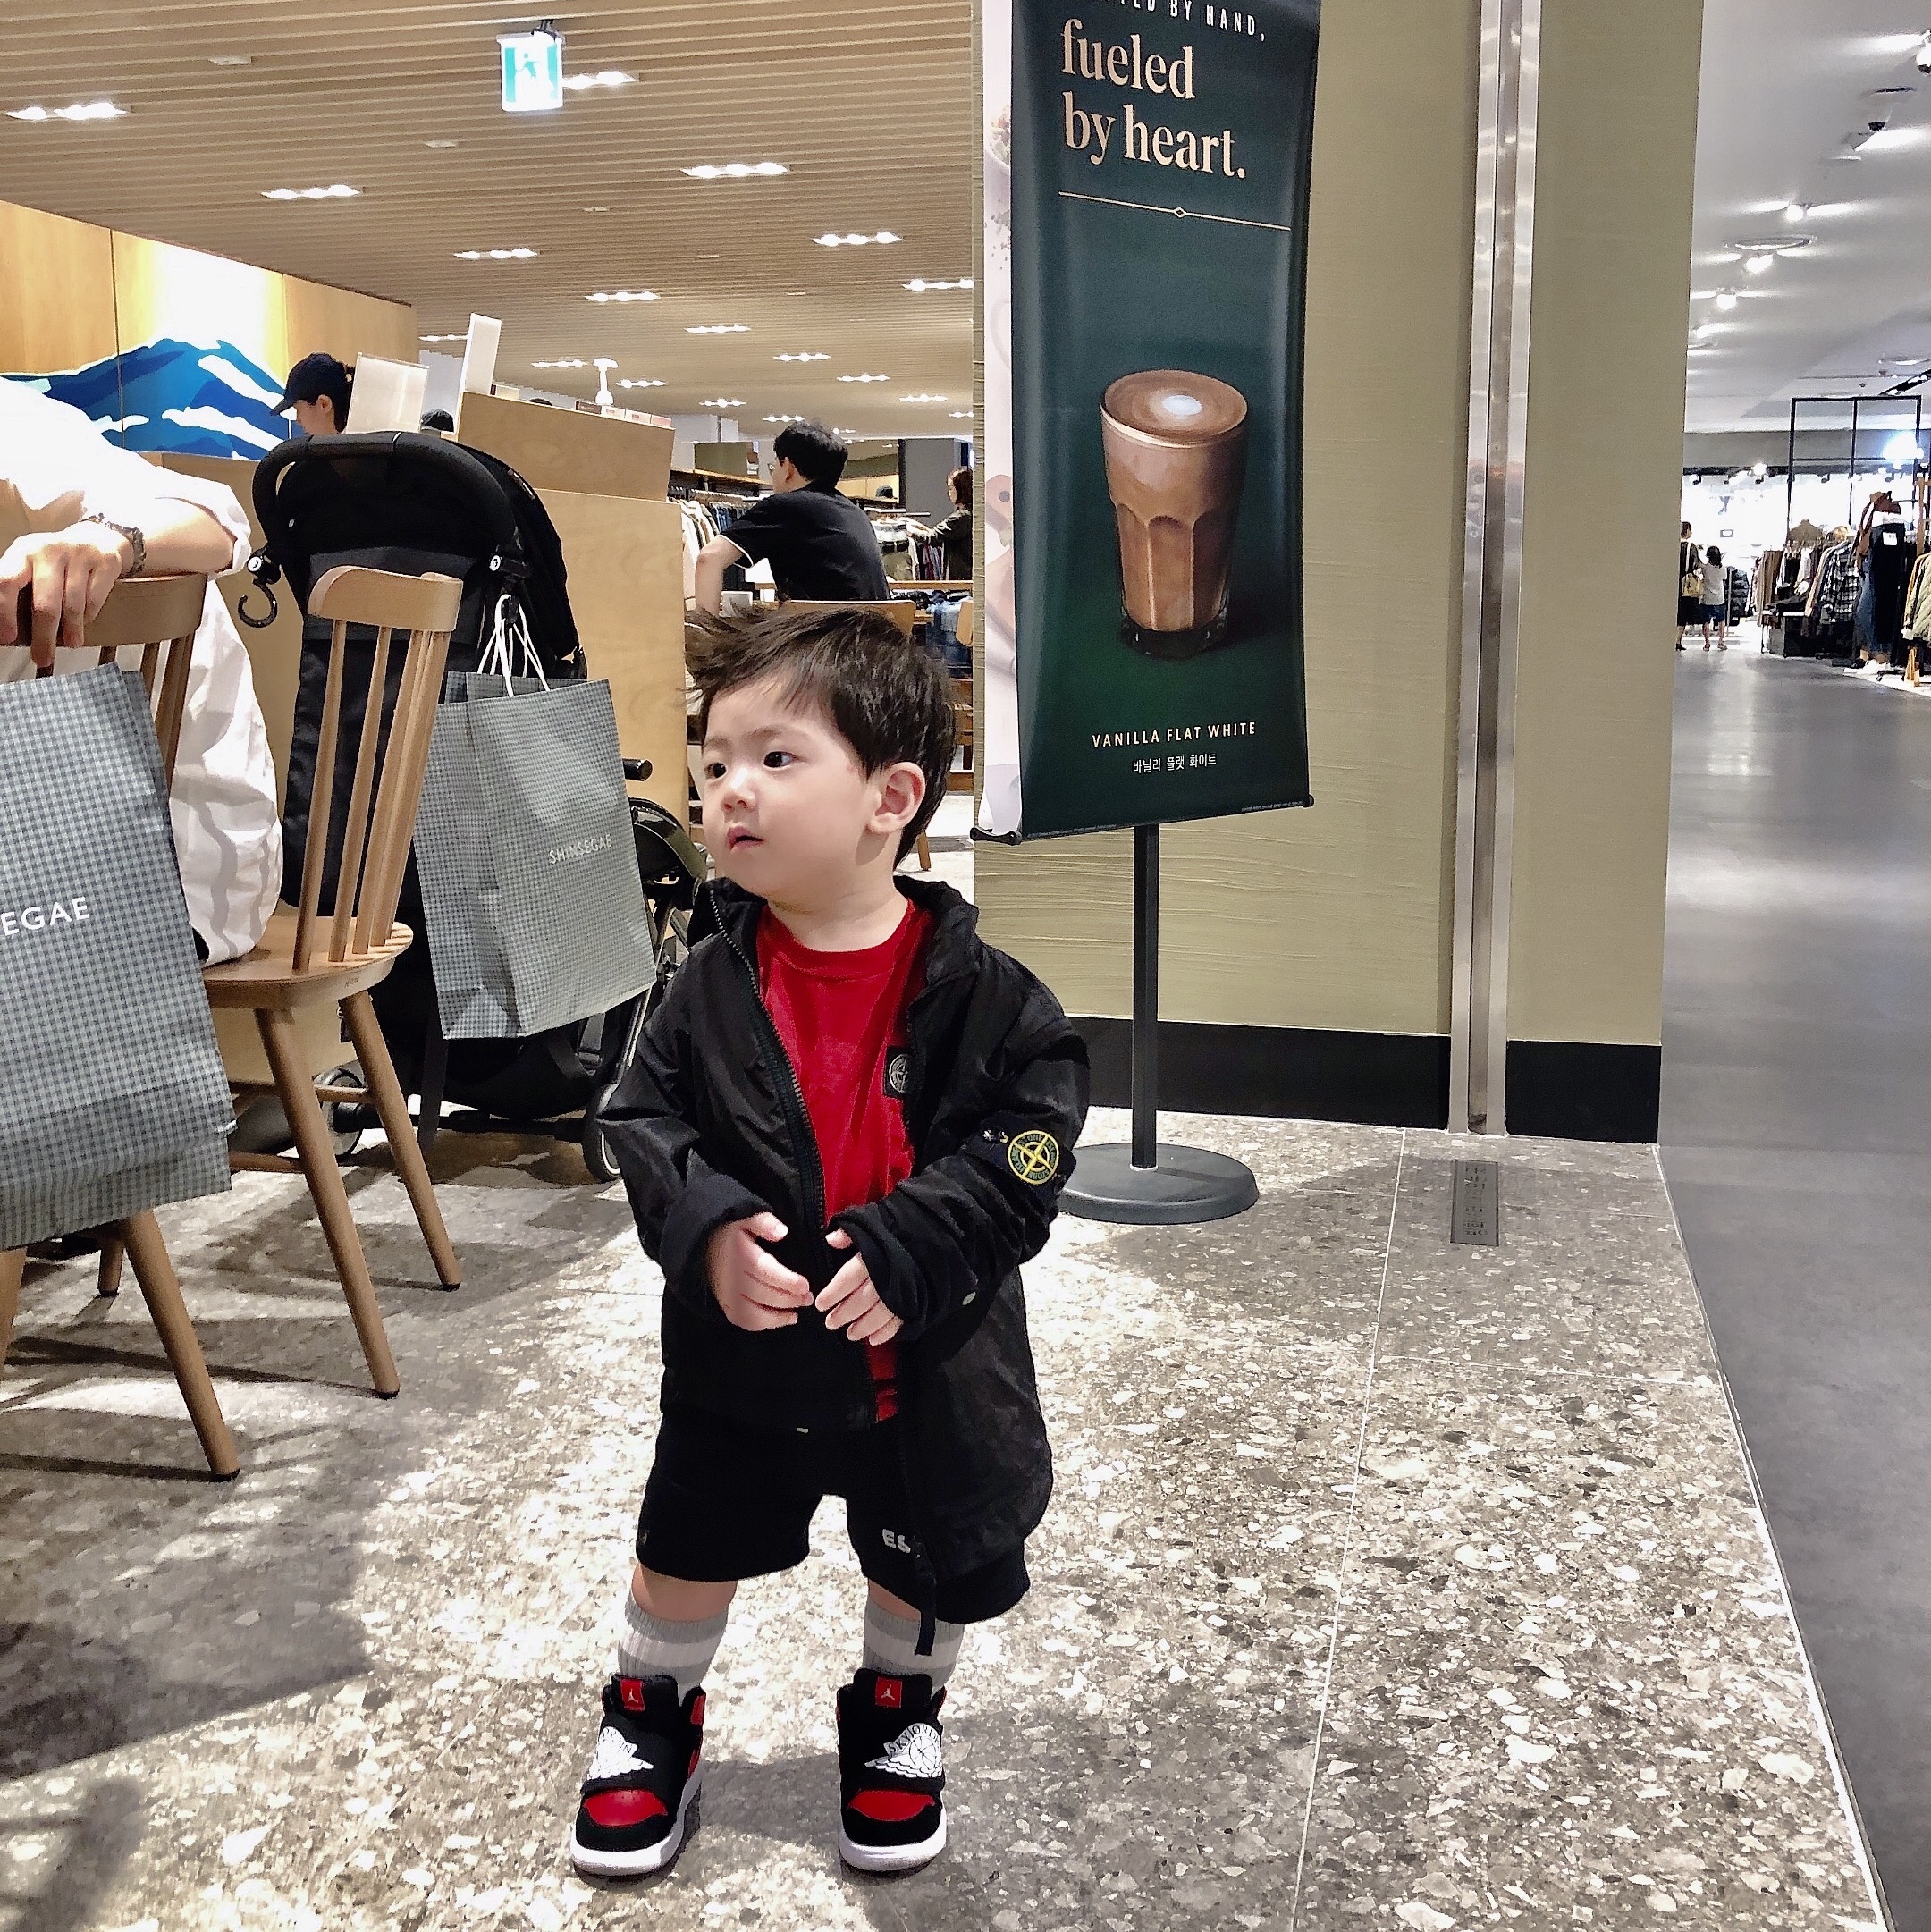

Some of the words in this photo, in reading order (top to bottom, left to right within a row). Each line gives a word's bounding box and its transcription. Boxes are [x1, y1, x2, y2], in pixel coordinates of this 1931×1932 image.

[1170, 0, 1193, 21] BY
[1206, 4, 1265, 42] HAND,
[1061, 18, 1196, 99] fueled
[1062, 90, 1117, 165] by
[1123, 104, 1246, 179] heart.
[1092, 730, 1160, 748] VANILLA
[1167, 726, 1202, 742] FLAT
[1208, 721, 1256, 738] WHITE
[1133, 757, 1162, 774] 바닐라
[1166, 755, 1185, 771] 플랫
[1189, 753, 1217, 769] 화이트
[881, 1528, 921, 1559] ES
